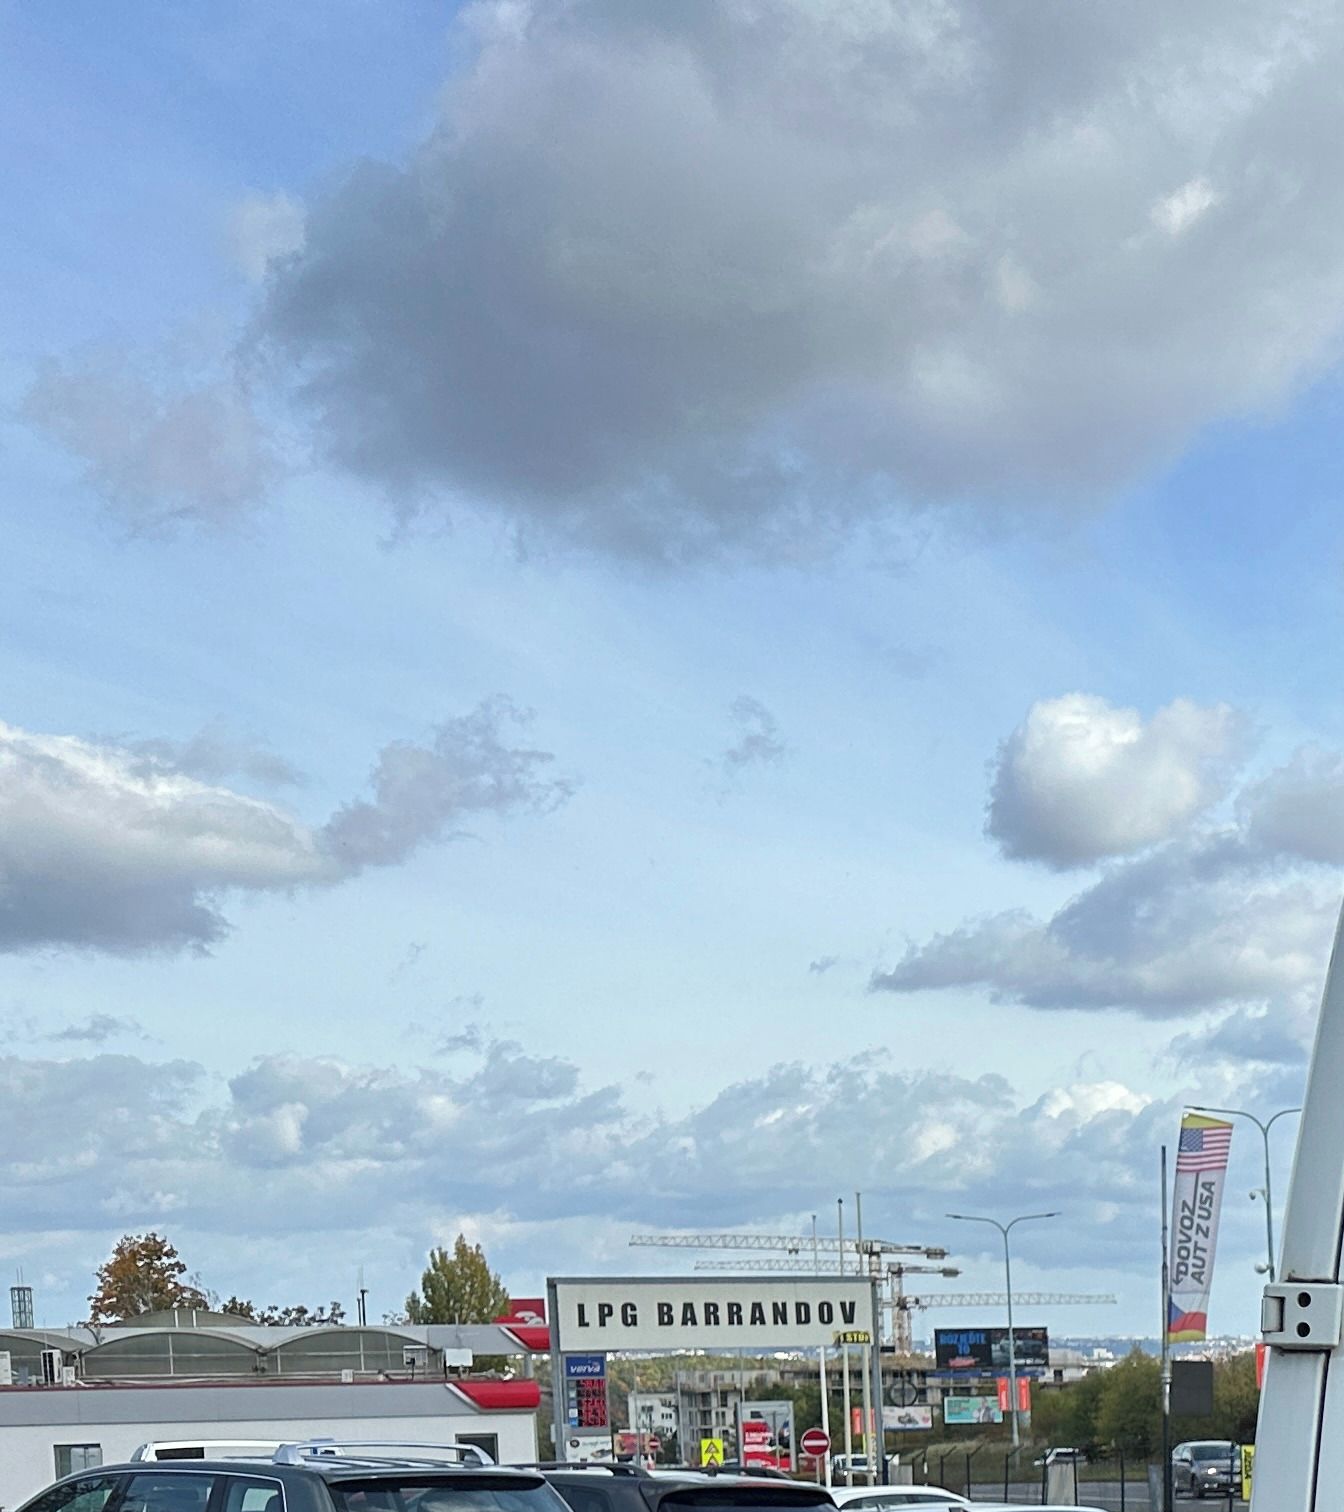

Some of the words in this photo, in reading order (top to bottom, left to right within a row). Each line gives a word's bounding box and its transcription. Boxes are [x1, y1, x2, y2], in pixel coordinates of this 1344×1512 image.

[1198, 1180, 1216, 1222] USA
[1175, 1199, 1195, 1278] DOVOZ
[1196, 1223, 1210, 1239] Z
[1190, 1243, 1208, 1286] AUT
[577, 1303, 639, 1328] LPG
[657, 1301, 857, 1326] BARRANDOV
